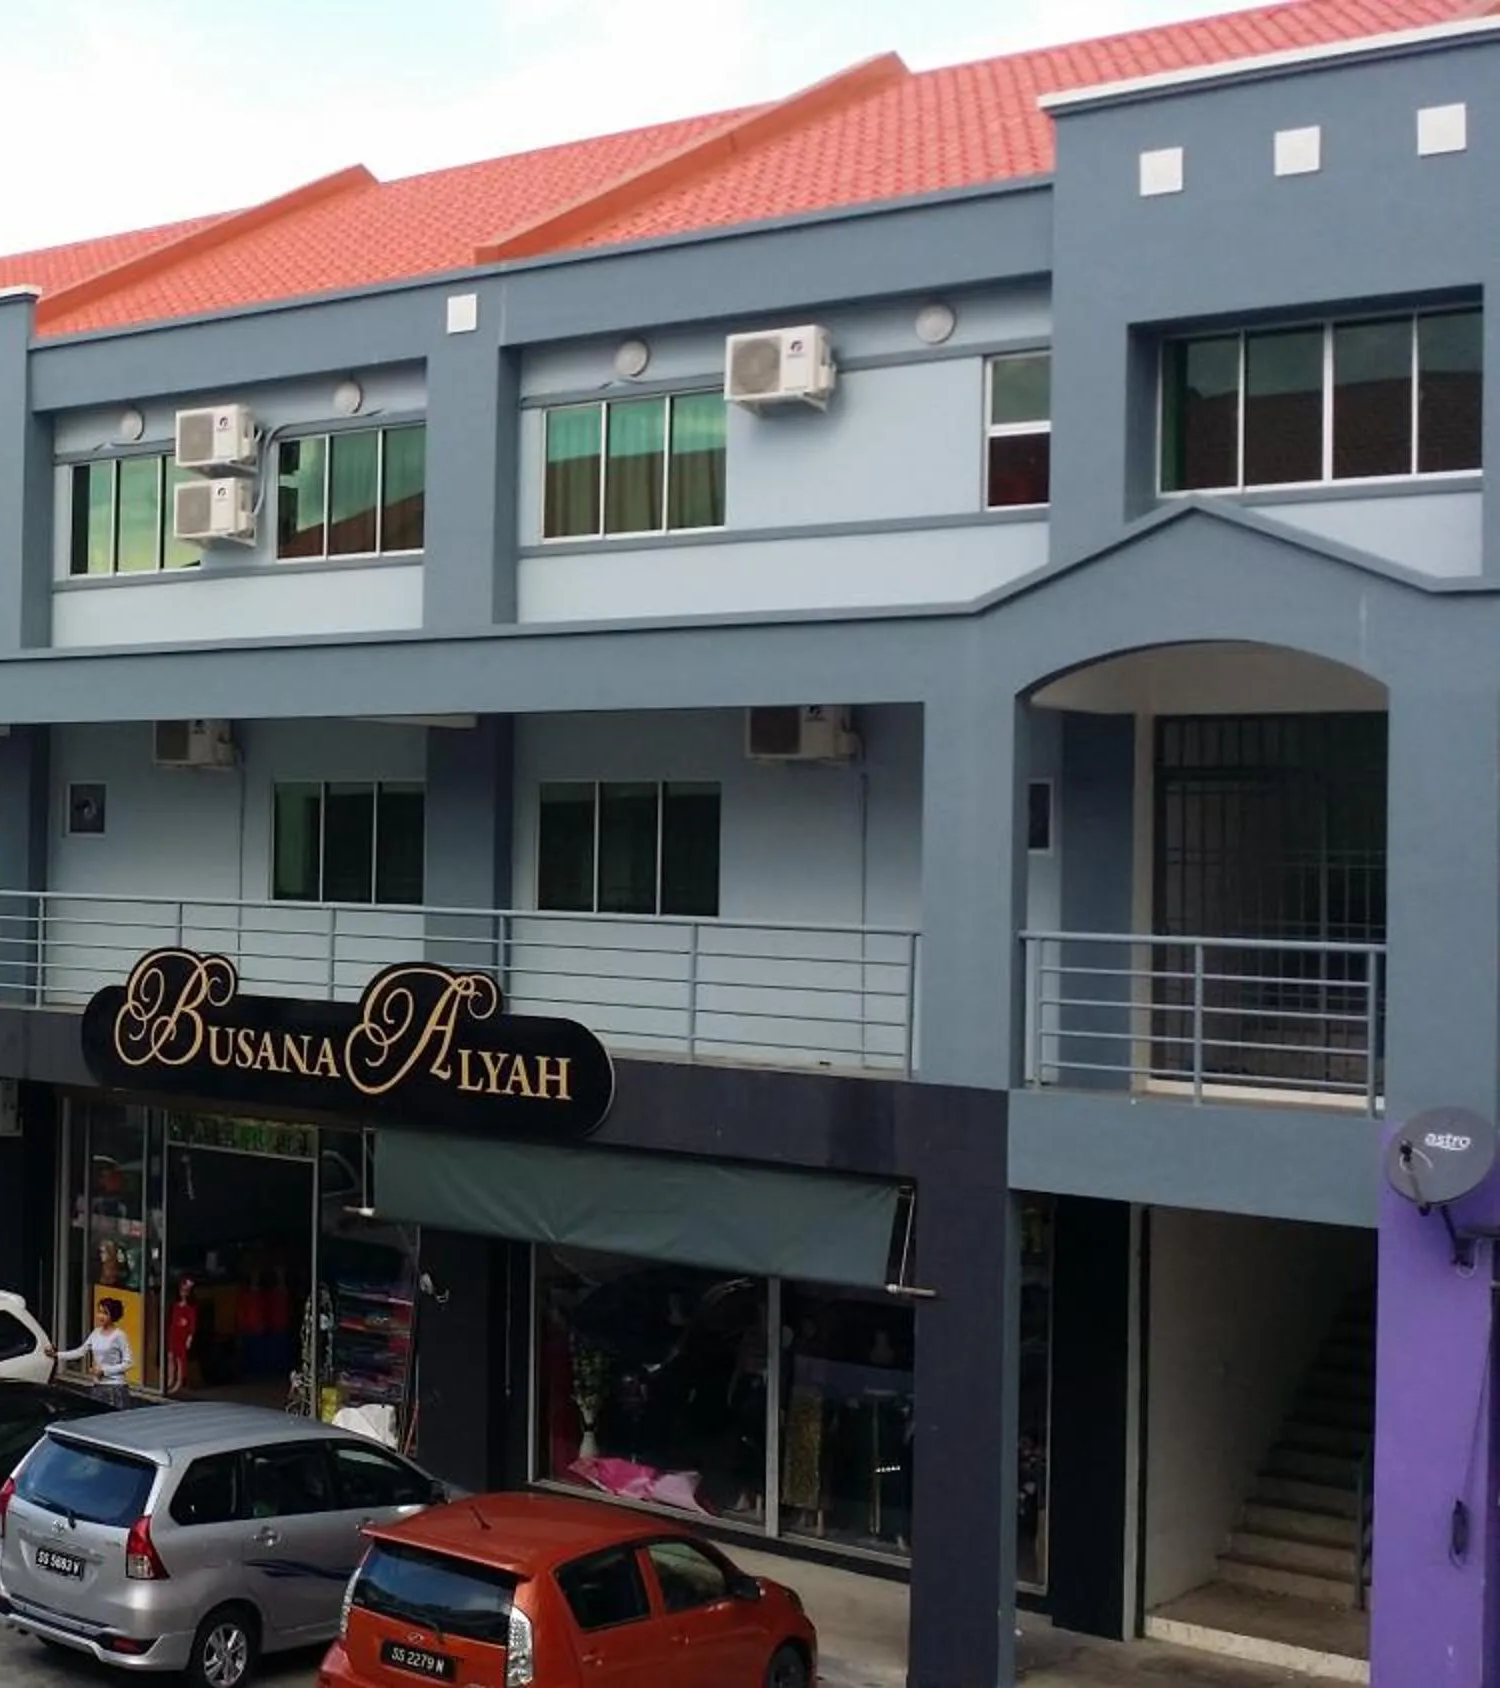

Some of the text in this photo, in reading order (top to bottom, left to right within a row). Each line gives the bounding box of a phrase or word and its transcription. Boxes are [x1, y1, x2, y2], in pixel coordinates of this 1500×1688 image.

[115, 950, 572, 1101] BUSANA ALYAH
[1425, 1133, 1471, 1151] astro
[391, 1647, 405, 1662] SS
[406, 1651, 435, 1669] 2279
